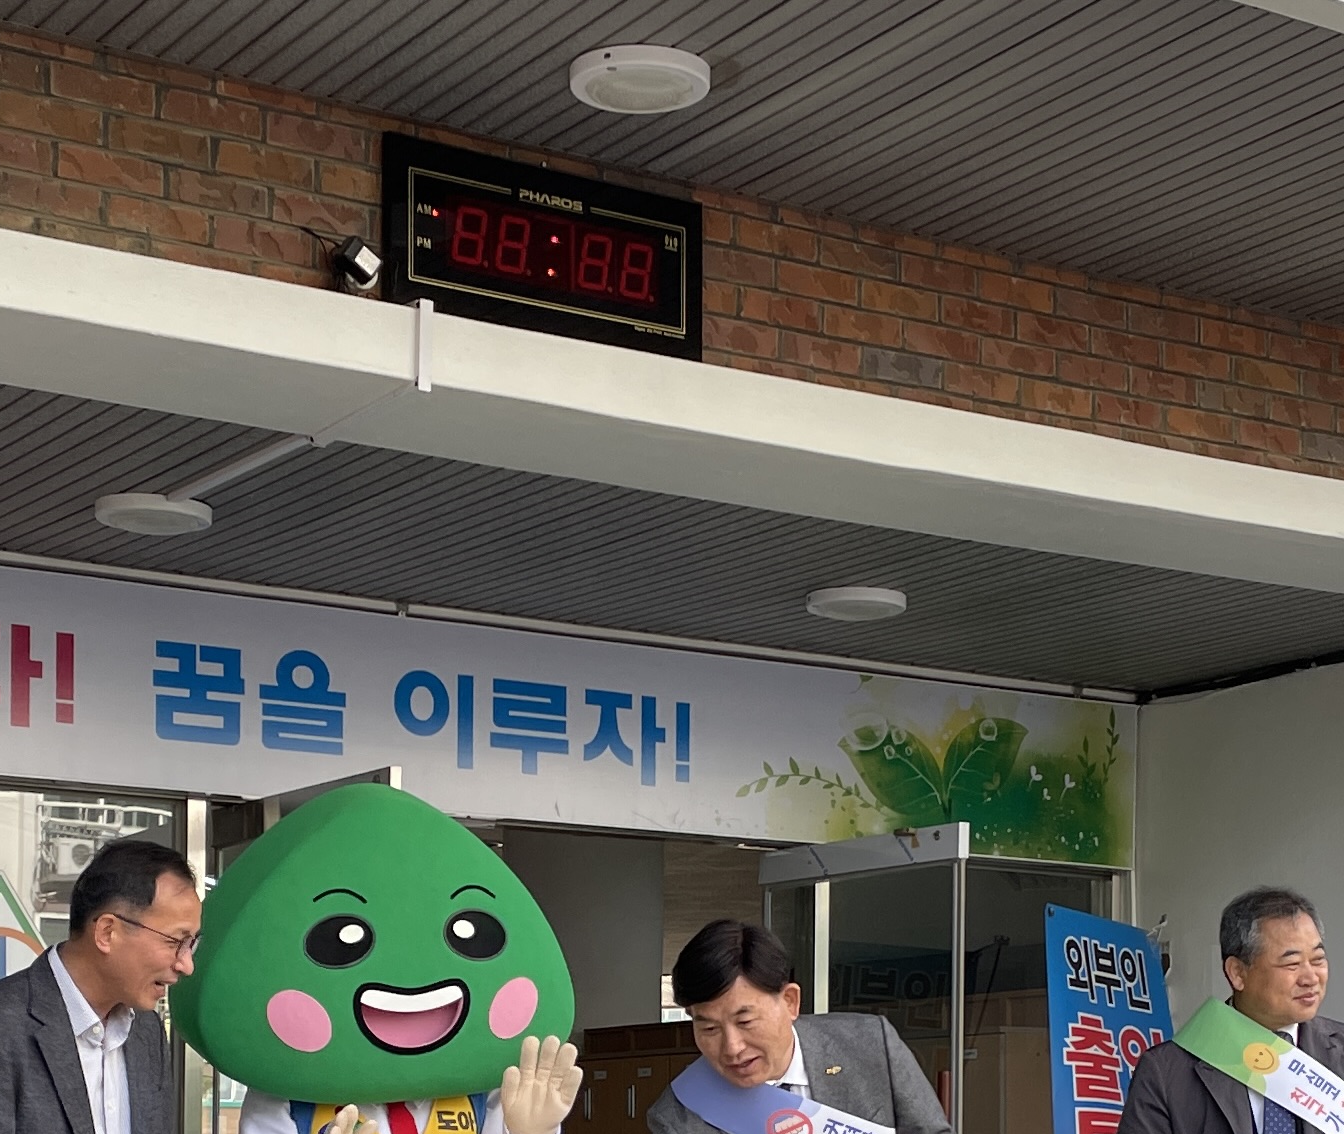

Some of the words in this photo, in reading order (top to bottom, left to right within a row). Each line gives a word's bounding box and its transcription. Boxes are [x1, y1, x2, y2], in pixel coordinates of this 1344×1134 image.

[519, 188, 583, 212] PHAROS
[416, 236, 431, 250] PM
[152, 640, 347, 755] 꿈을
[393, 669, 691, 787] 이루자!
[1064, 936, 1152, 1014] 외부인
[1287, 1058, 1341, 1101] 무심코
[437, 1111, 474, 1132] 도아
